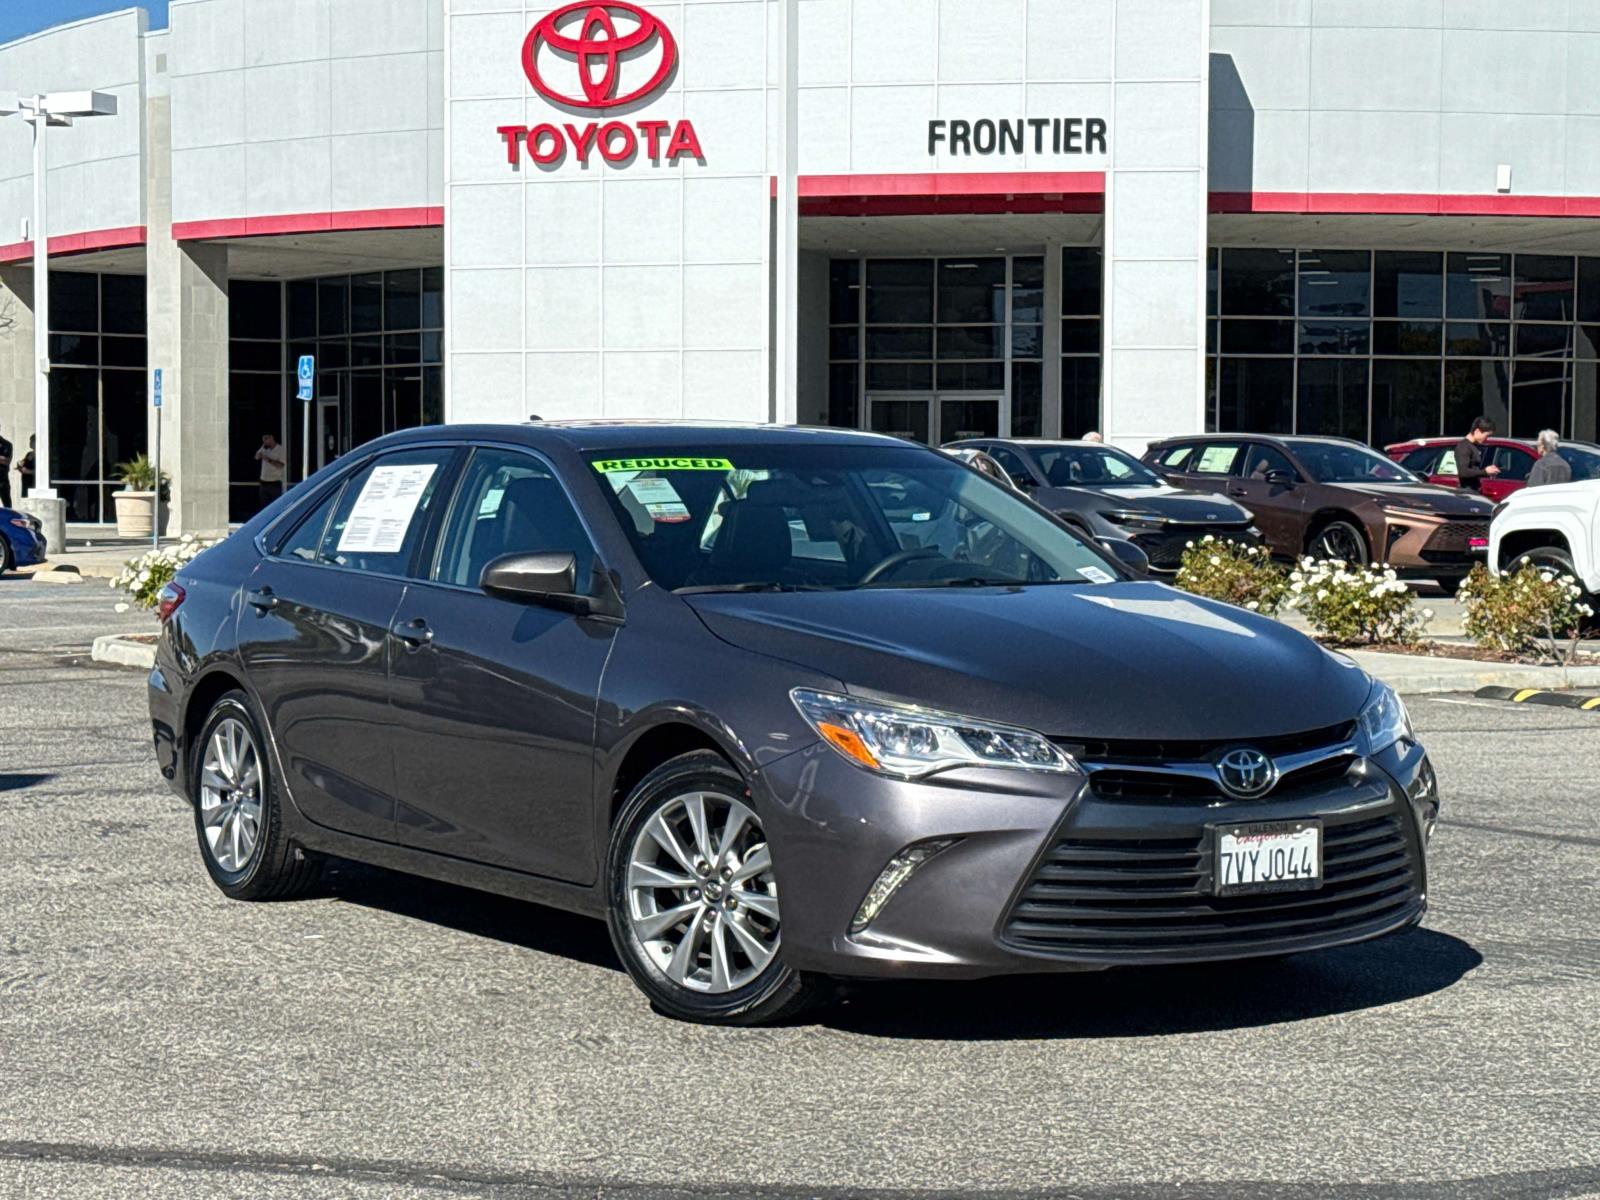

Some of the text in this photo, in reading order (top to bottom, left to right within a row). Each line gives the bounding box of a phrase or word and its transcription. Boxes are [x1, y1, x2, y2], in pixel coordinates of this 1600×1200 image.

[497, 119, 703, 164] TOYOTA
[928, 117, 1107, 156] FRONTIER
[601, 459, 724, 470] REDUCED
[1248, 823, 1289, 834] VALENCIA
[1221, 846, 1312, 885] 7VYJ044
